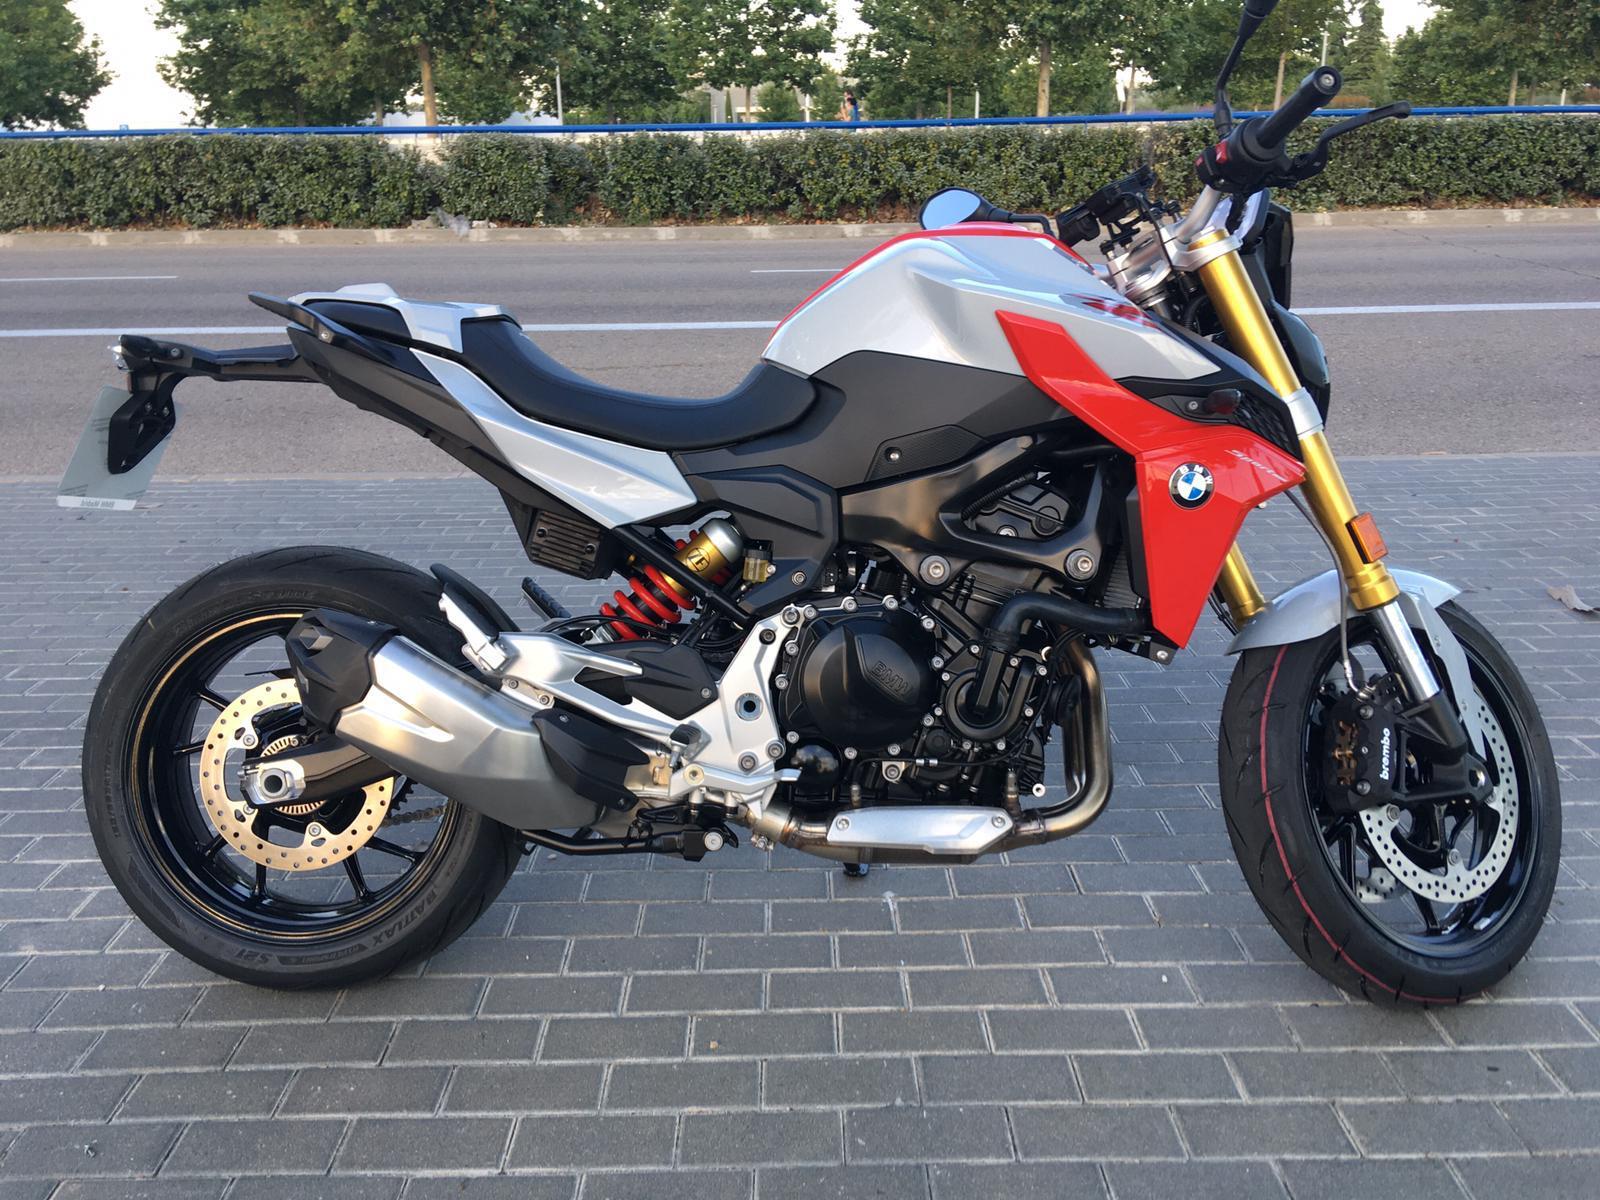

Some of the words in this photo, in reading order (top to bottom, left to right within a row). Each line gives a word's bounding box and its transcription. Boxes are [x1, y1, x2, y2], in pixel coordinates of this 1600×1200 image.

[1179, 464, 1213, 484] BMW
[871, 660, 909, 697] BMW
[1379, 727, 1390, 780] brembo
